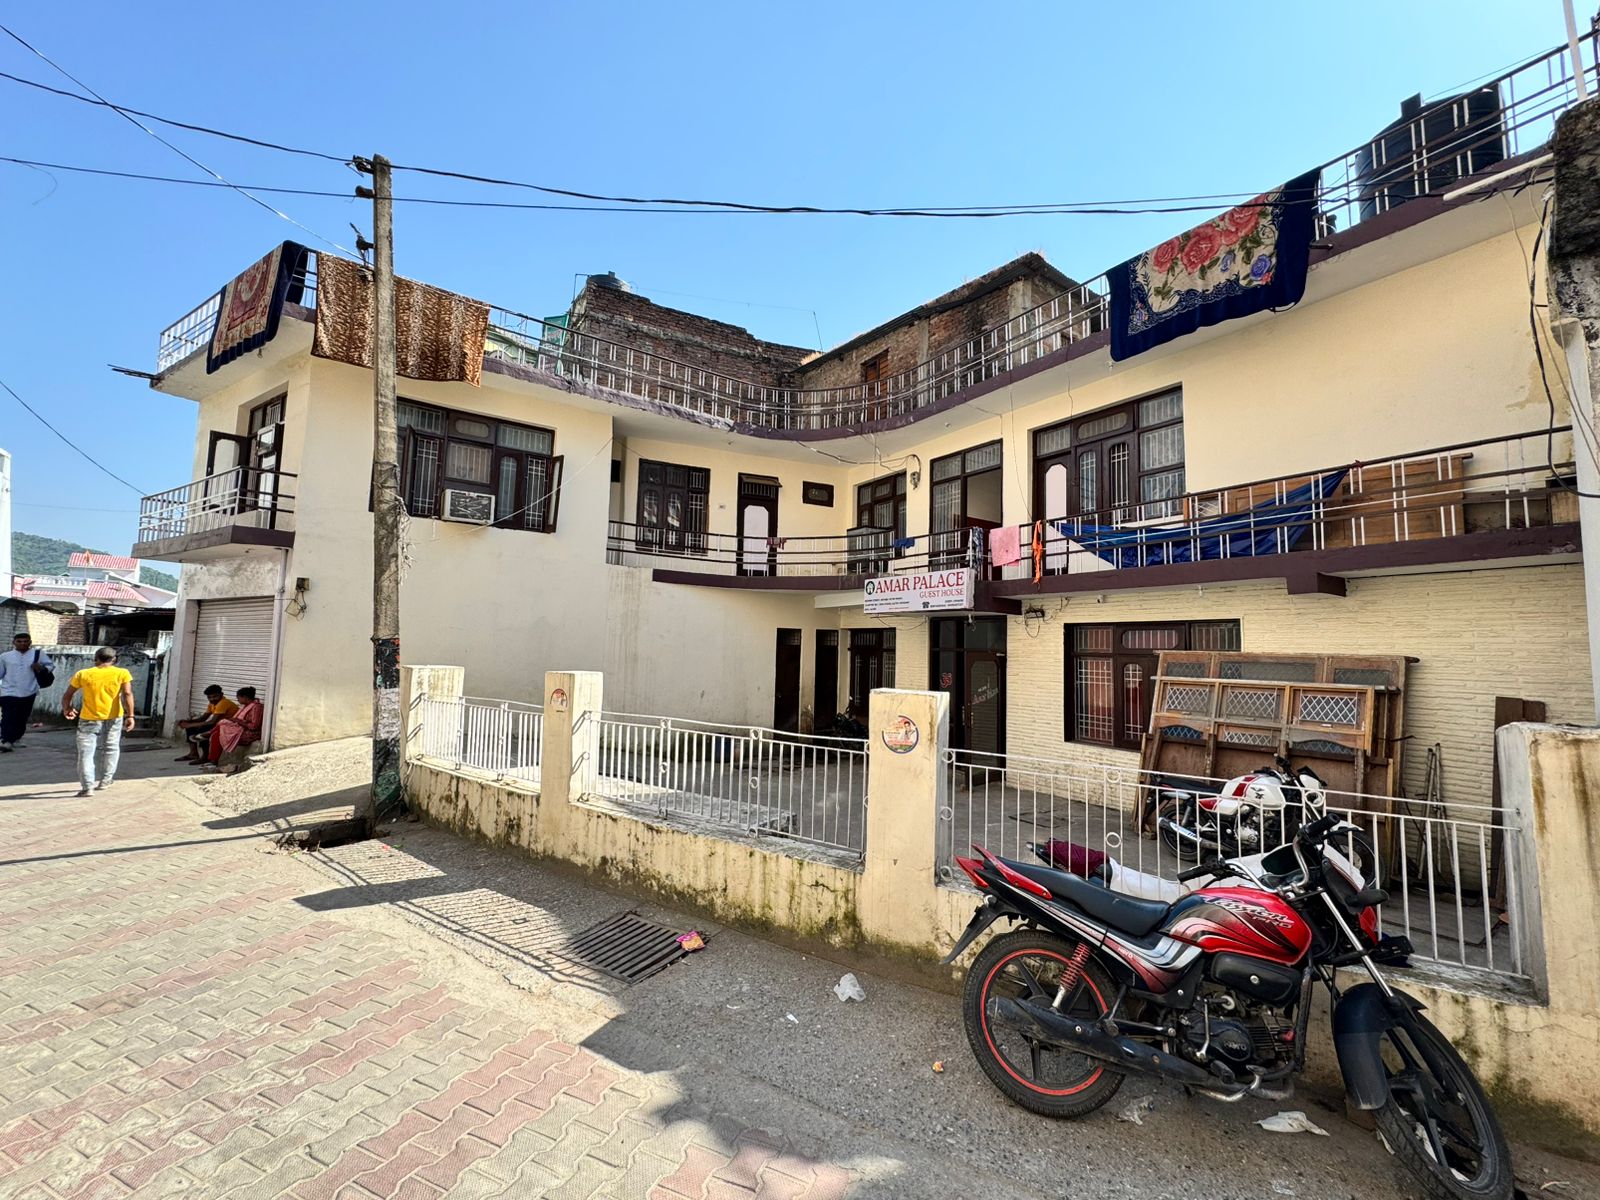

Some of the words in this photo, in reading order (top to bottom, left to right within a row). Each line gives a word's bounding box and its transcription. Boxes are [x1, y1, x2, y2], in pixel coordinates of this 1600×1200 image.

[875, 577, 910, 594] AMAR
[913, 571, 965, 590] PALACE
[920, 589, 940, 598] GUEST
[941, 588, 964, 598] HOUSE
